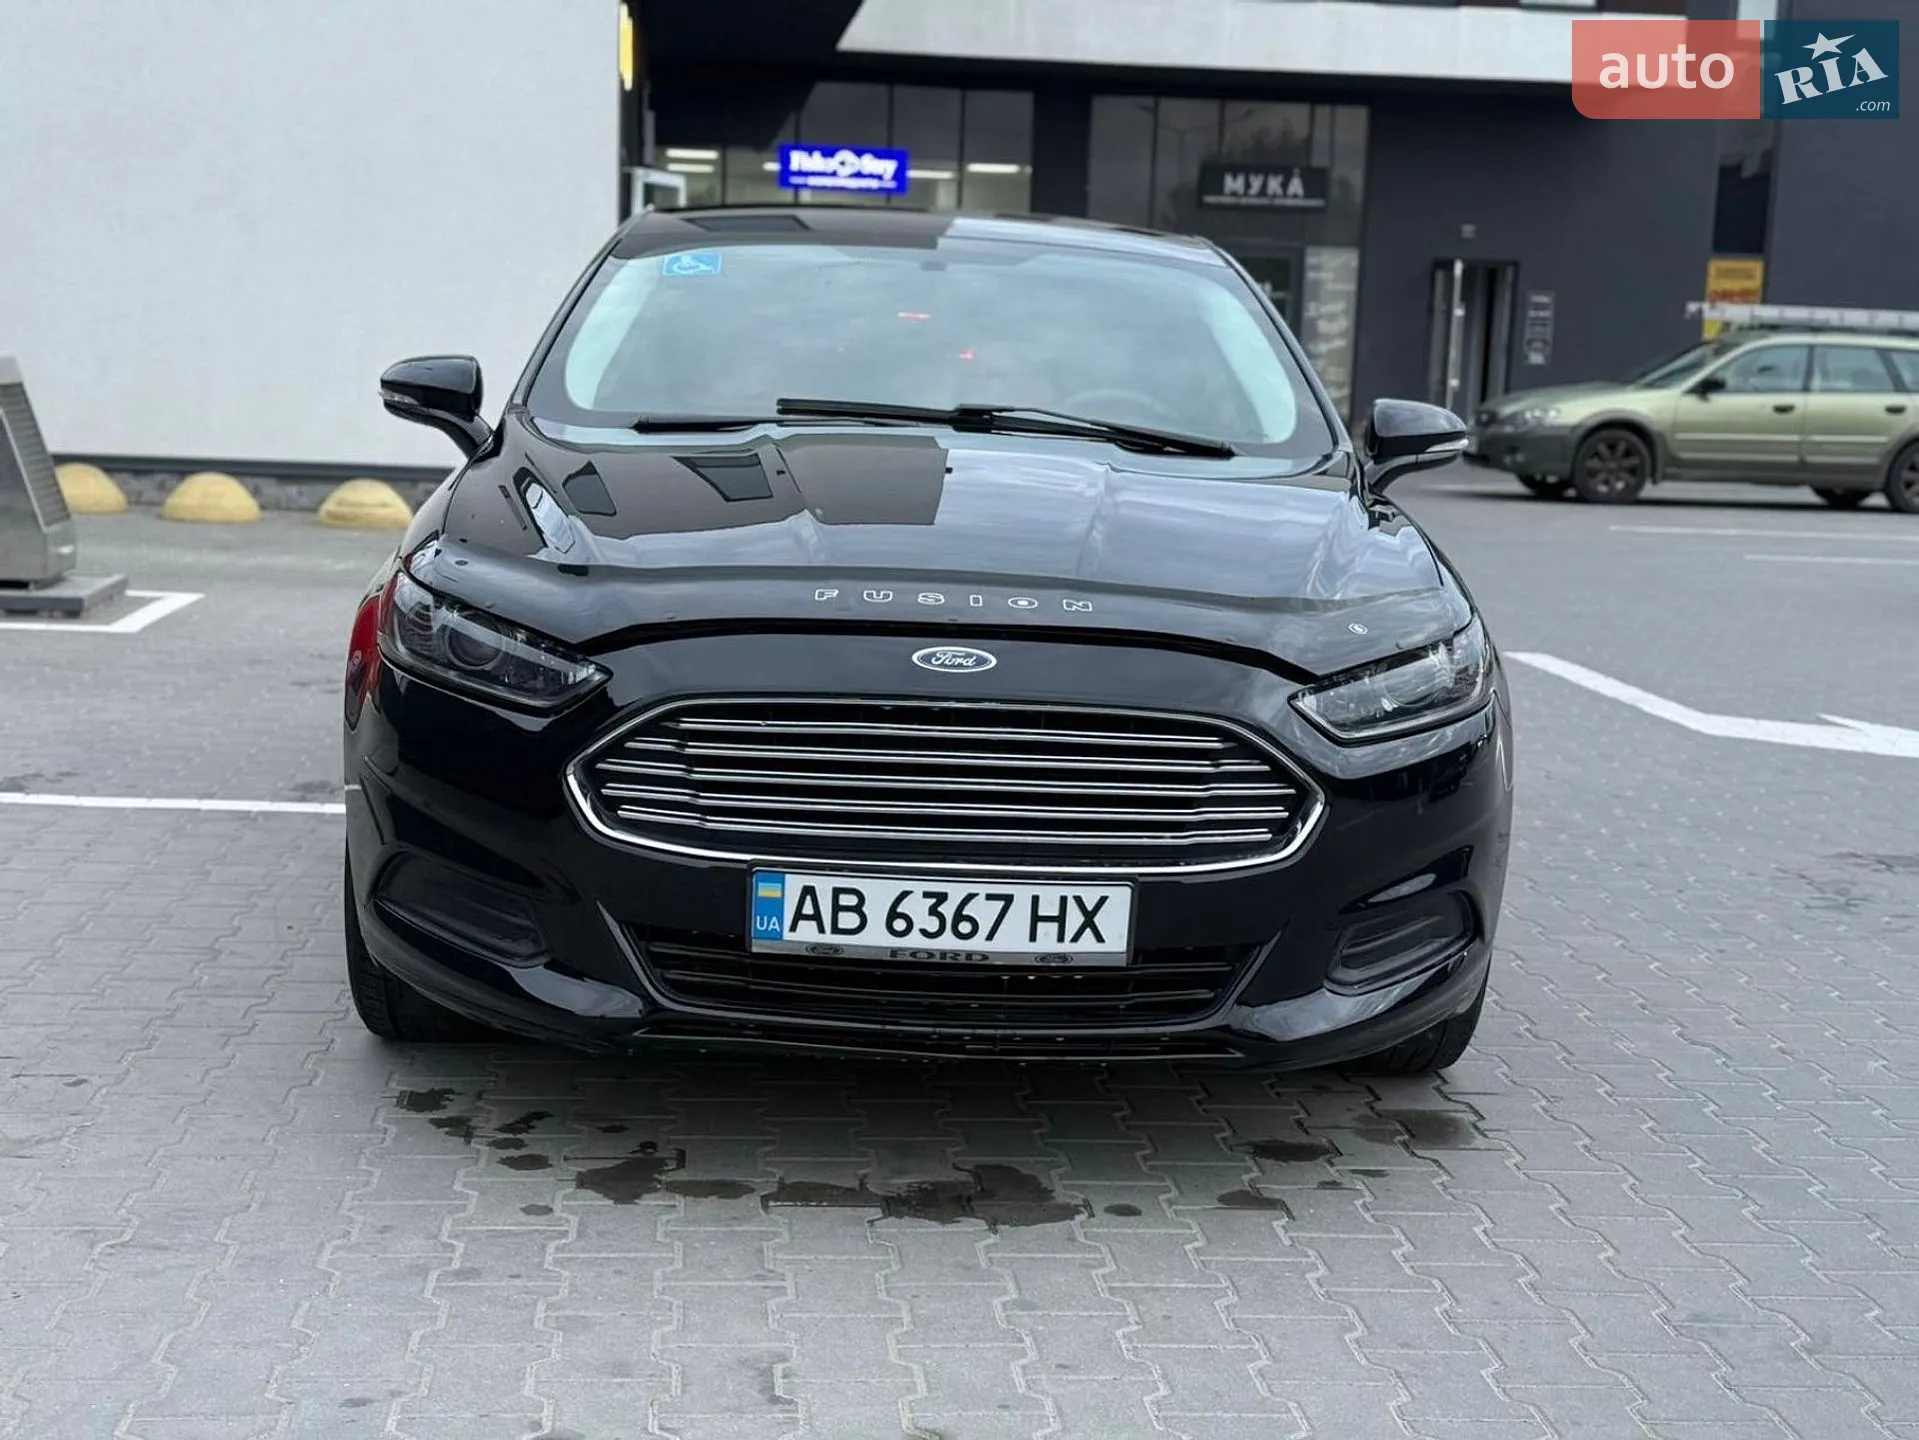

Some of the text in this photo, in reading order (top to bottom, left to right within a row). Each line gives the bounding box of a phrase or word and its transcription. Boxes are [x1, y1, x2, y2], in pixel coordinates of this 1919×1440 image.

[814, 588, 1093, 612] FUSION
[931, 651, 977, 668] Ford
[756, 914, 781, 932] UA
[788, 885, 1110, 944] AB 6367 HX
[889, 949, 990, 963] FORD
